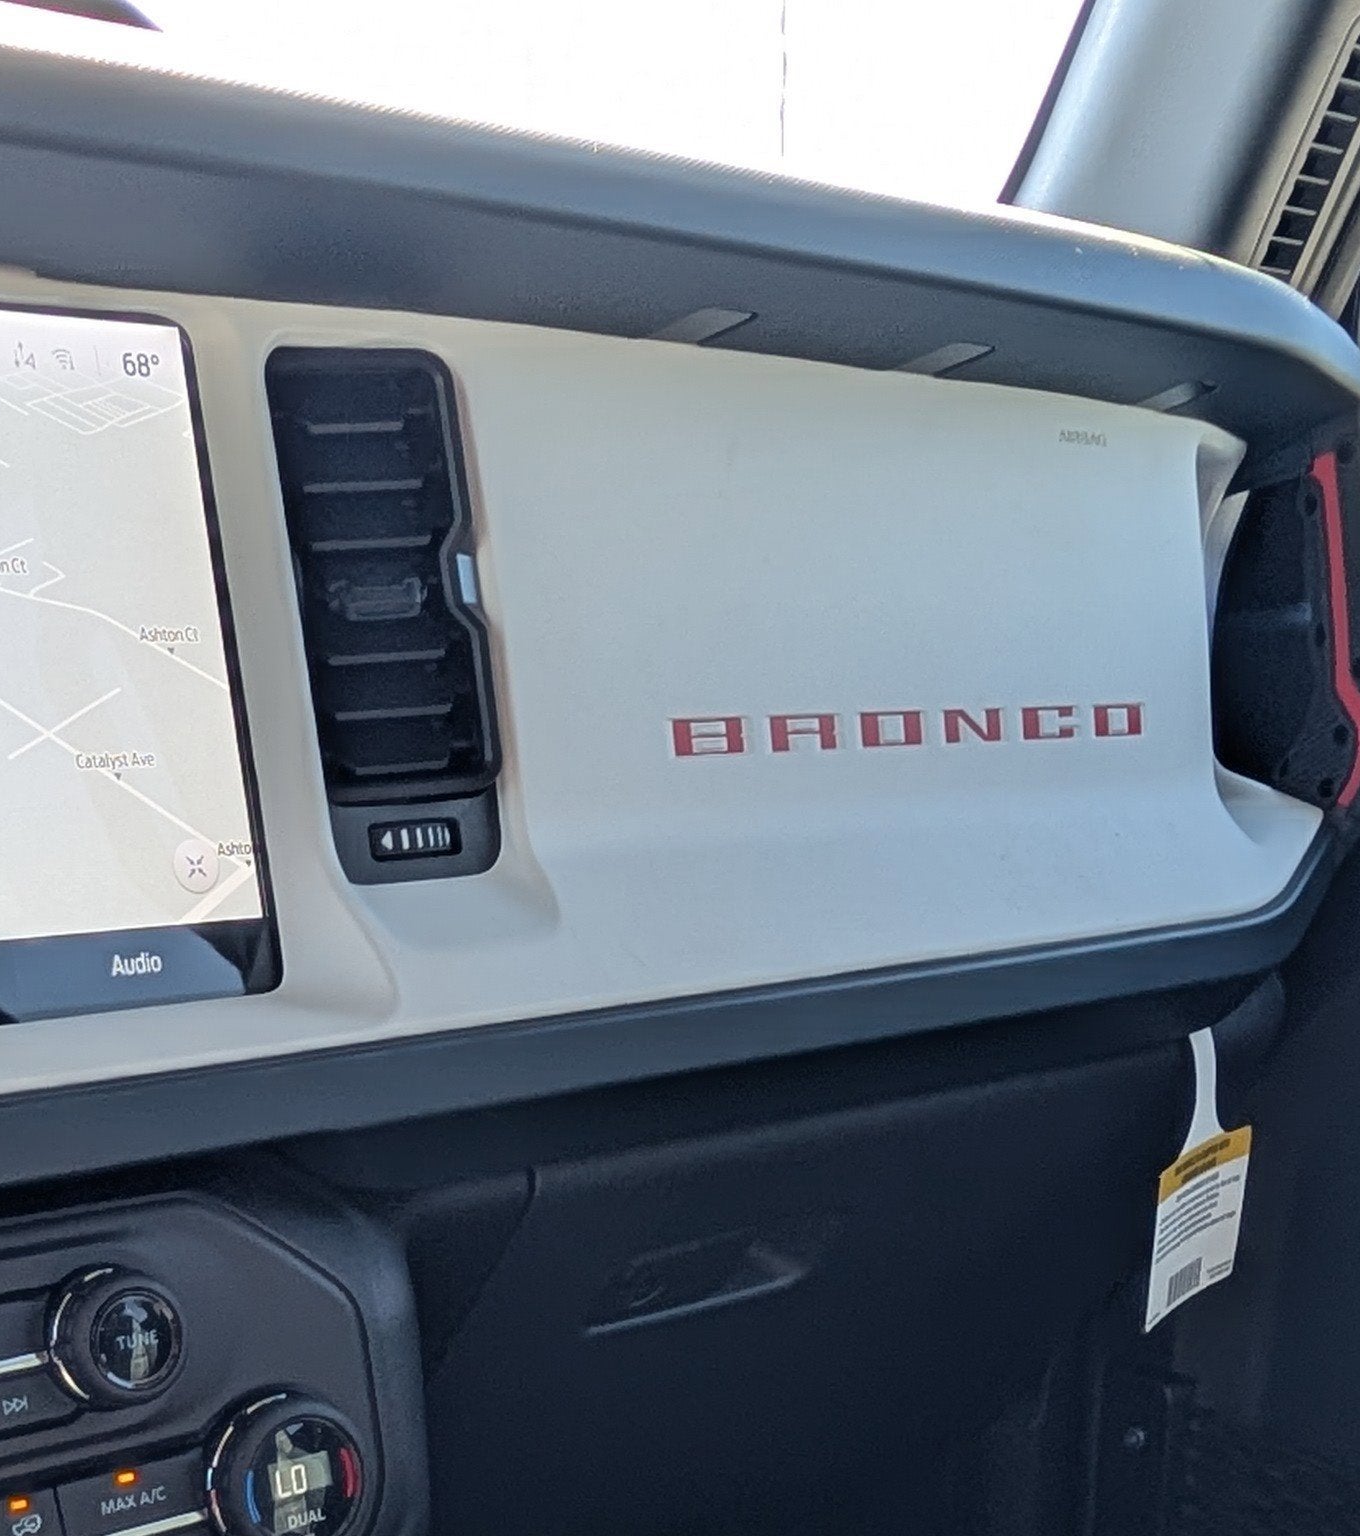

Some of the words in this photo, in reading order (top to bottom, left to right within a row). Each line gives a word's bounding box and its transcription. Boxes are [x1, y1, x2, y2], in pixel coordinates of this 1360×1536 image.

[11, 558, 26, 574] Ct
[140, 627, 182, 643] Ashton
[672, 704, 1143, 756] BRONCO
[76, 753, 131, 770] Catalyst
[133, 752, 155, 768] Ave
[111, 953, 162, 978] Audio
[116, 1329, 159, 1351] TUNE
[275, 1464, 308, 1498] LO
[101, 1497, 136, 1515] MAX
[140, 1486, 167, 1507] A/C
[288, 1507, 327, 1528] DUAL
